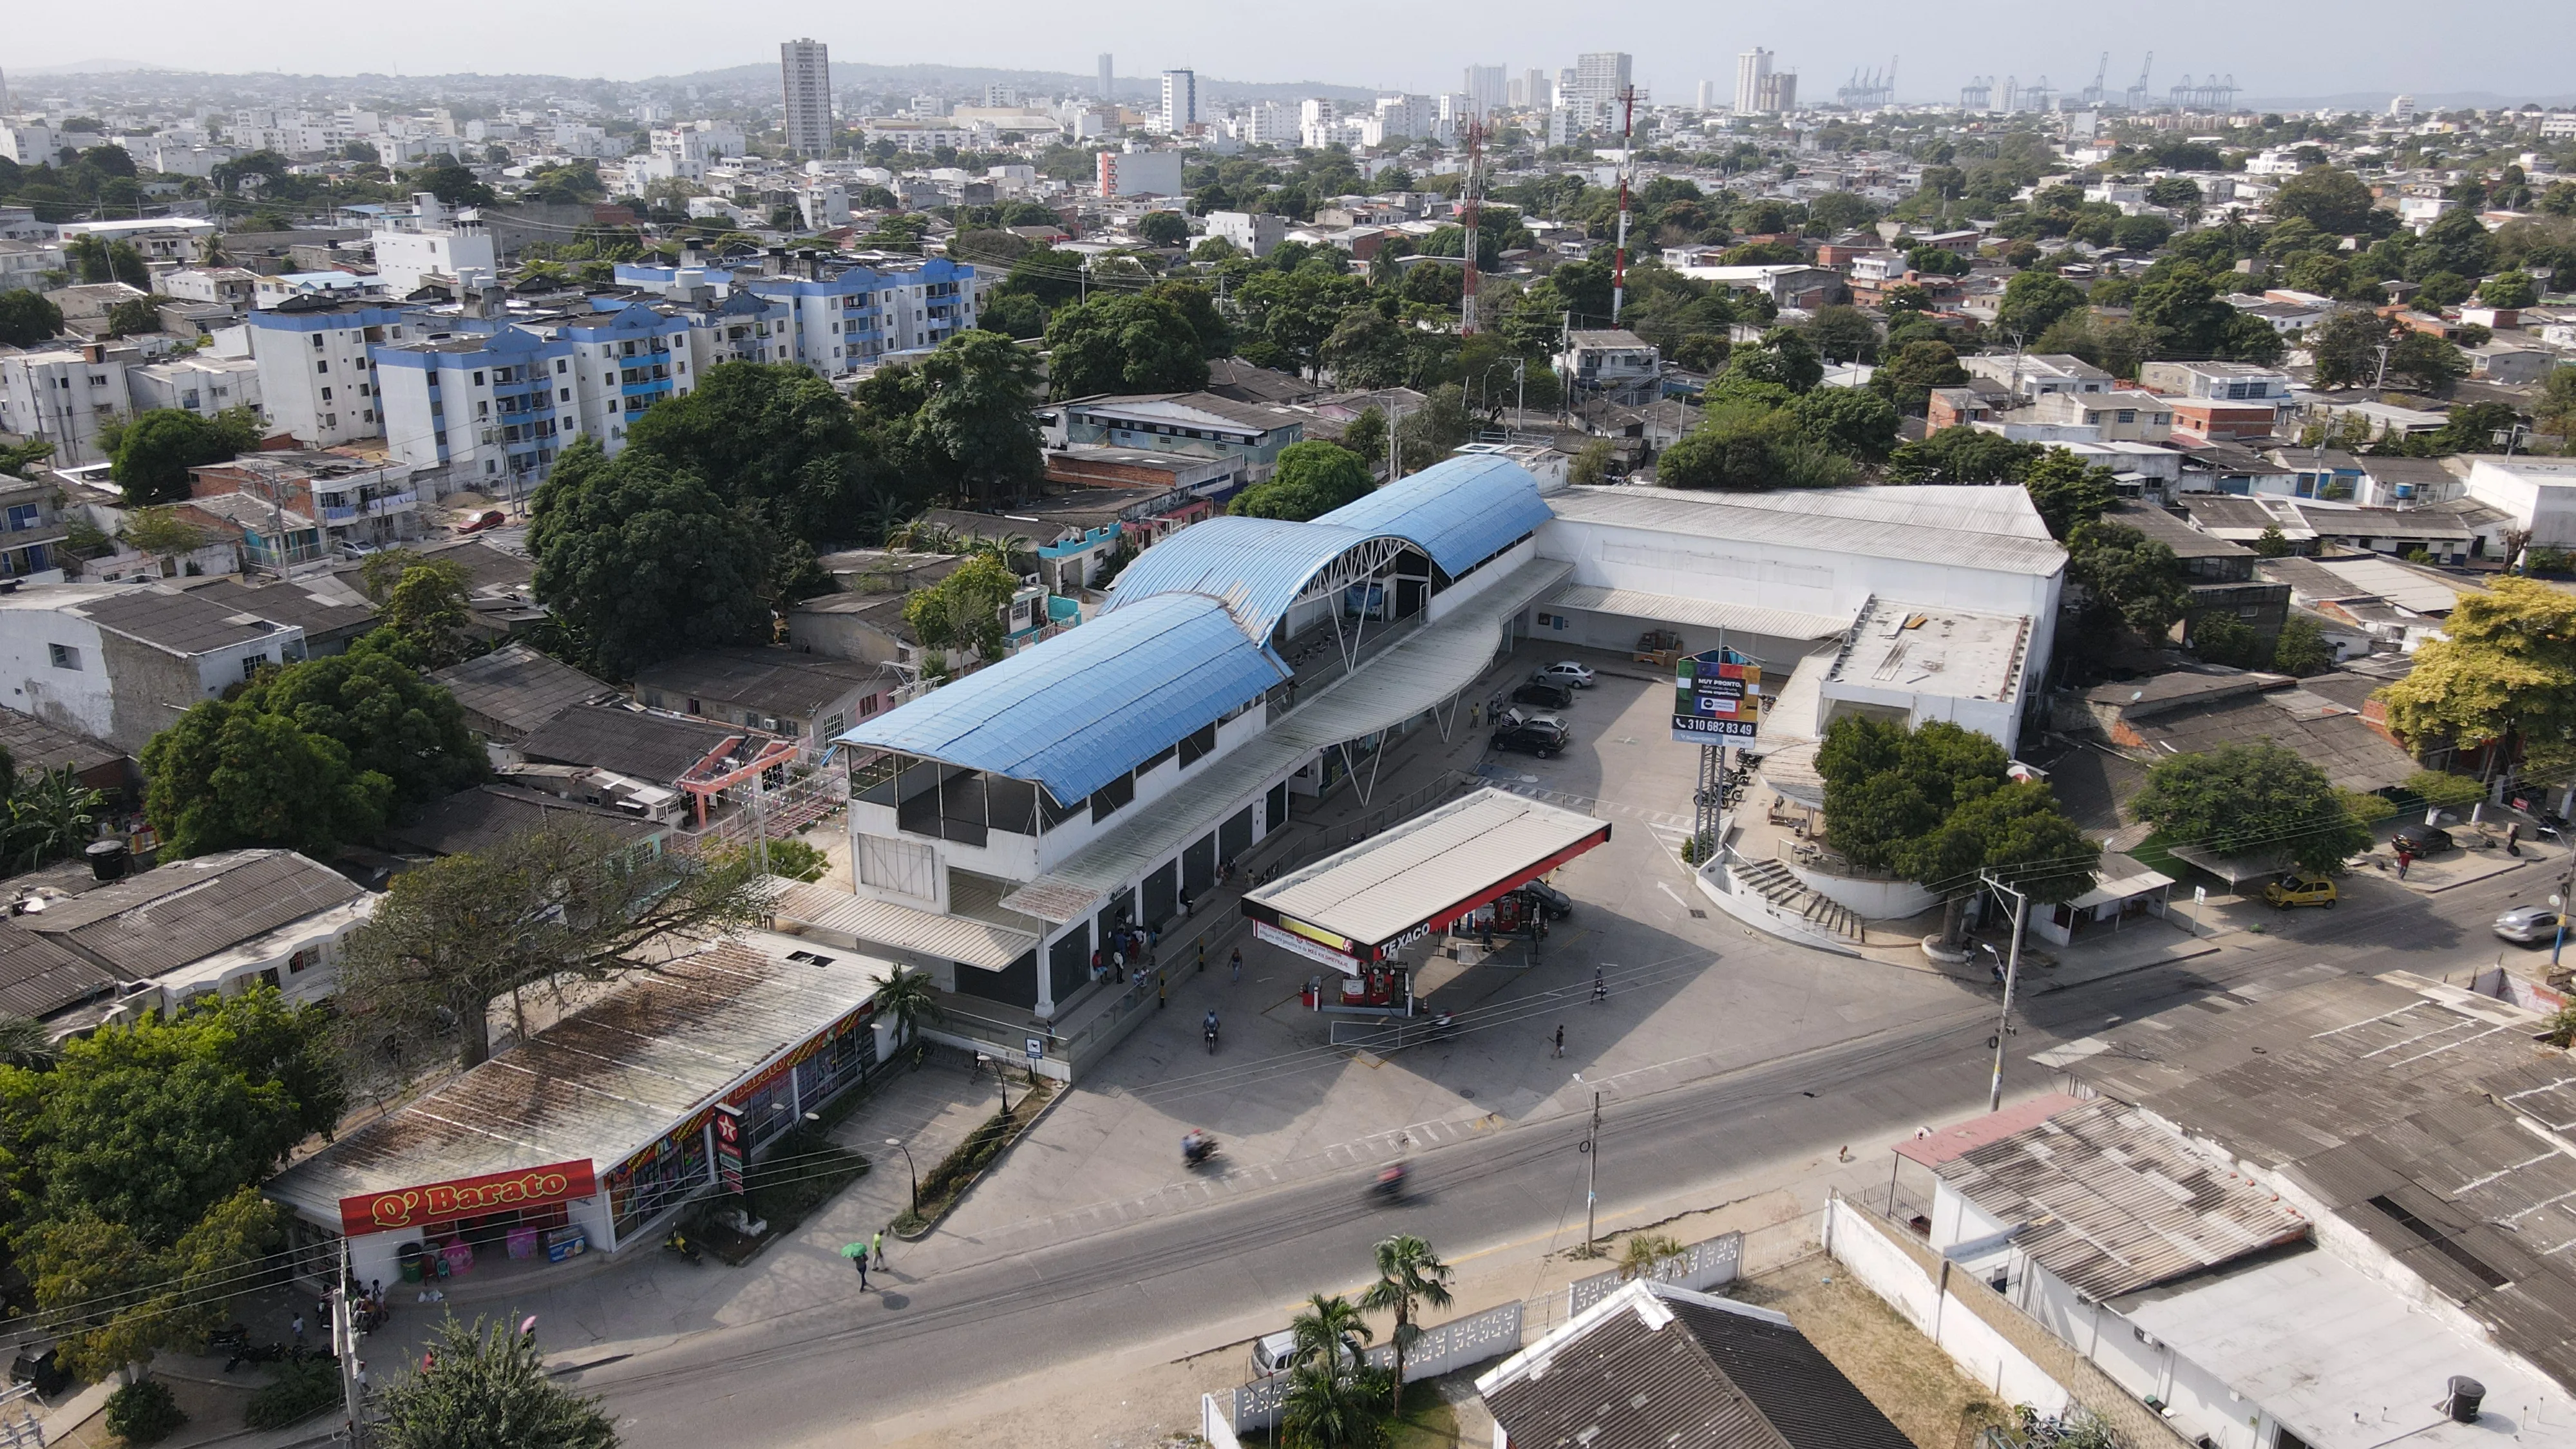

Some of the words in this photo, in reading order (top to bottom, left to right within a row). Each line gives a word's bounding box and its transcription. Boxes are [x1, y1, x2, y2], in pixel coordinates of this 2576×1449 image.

[1714, 679, 1742, 688] PRONTO,
[1688, 719, 1705, 731] 310
[1707, 721, 1725, 733] 682
[1727, 723, 1738, 734] 83
[1740, 724, 1752, 735] 49
[1381, 922, 1430, 958] TEXACO
[424, 1173, 568, 1215] Barato
